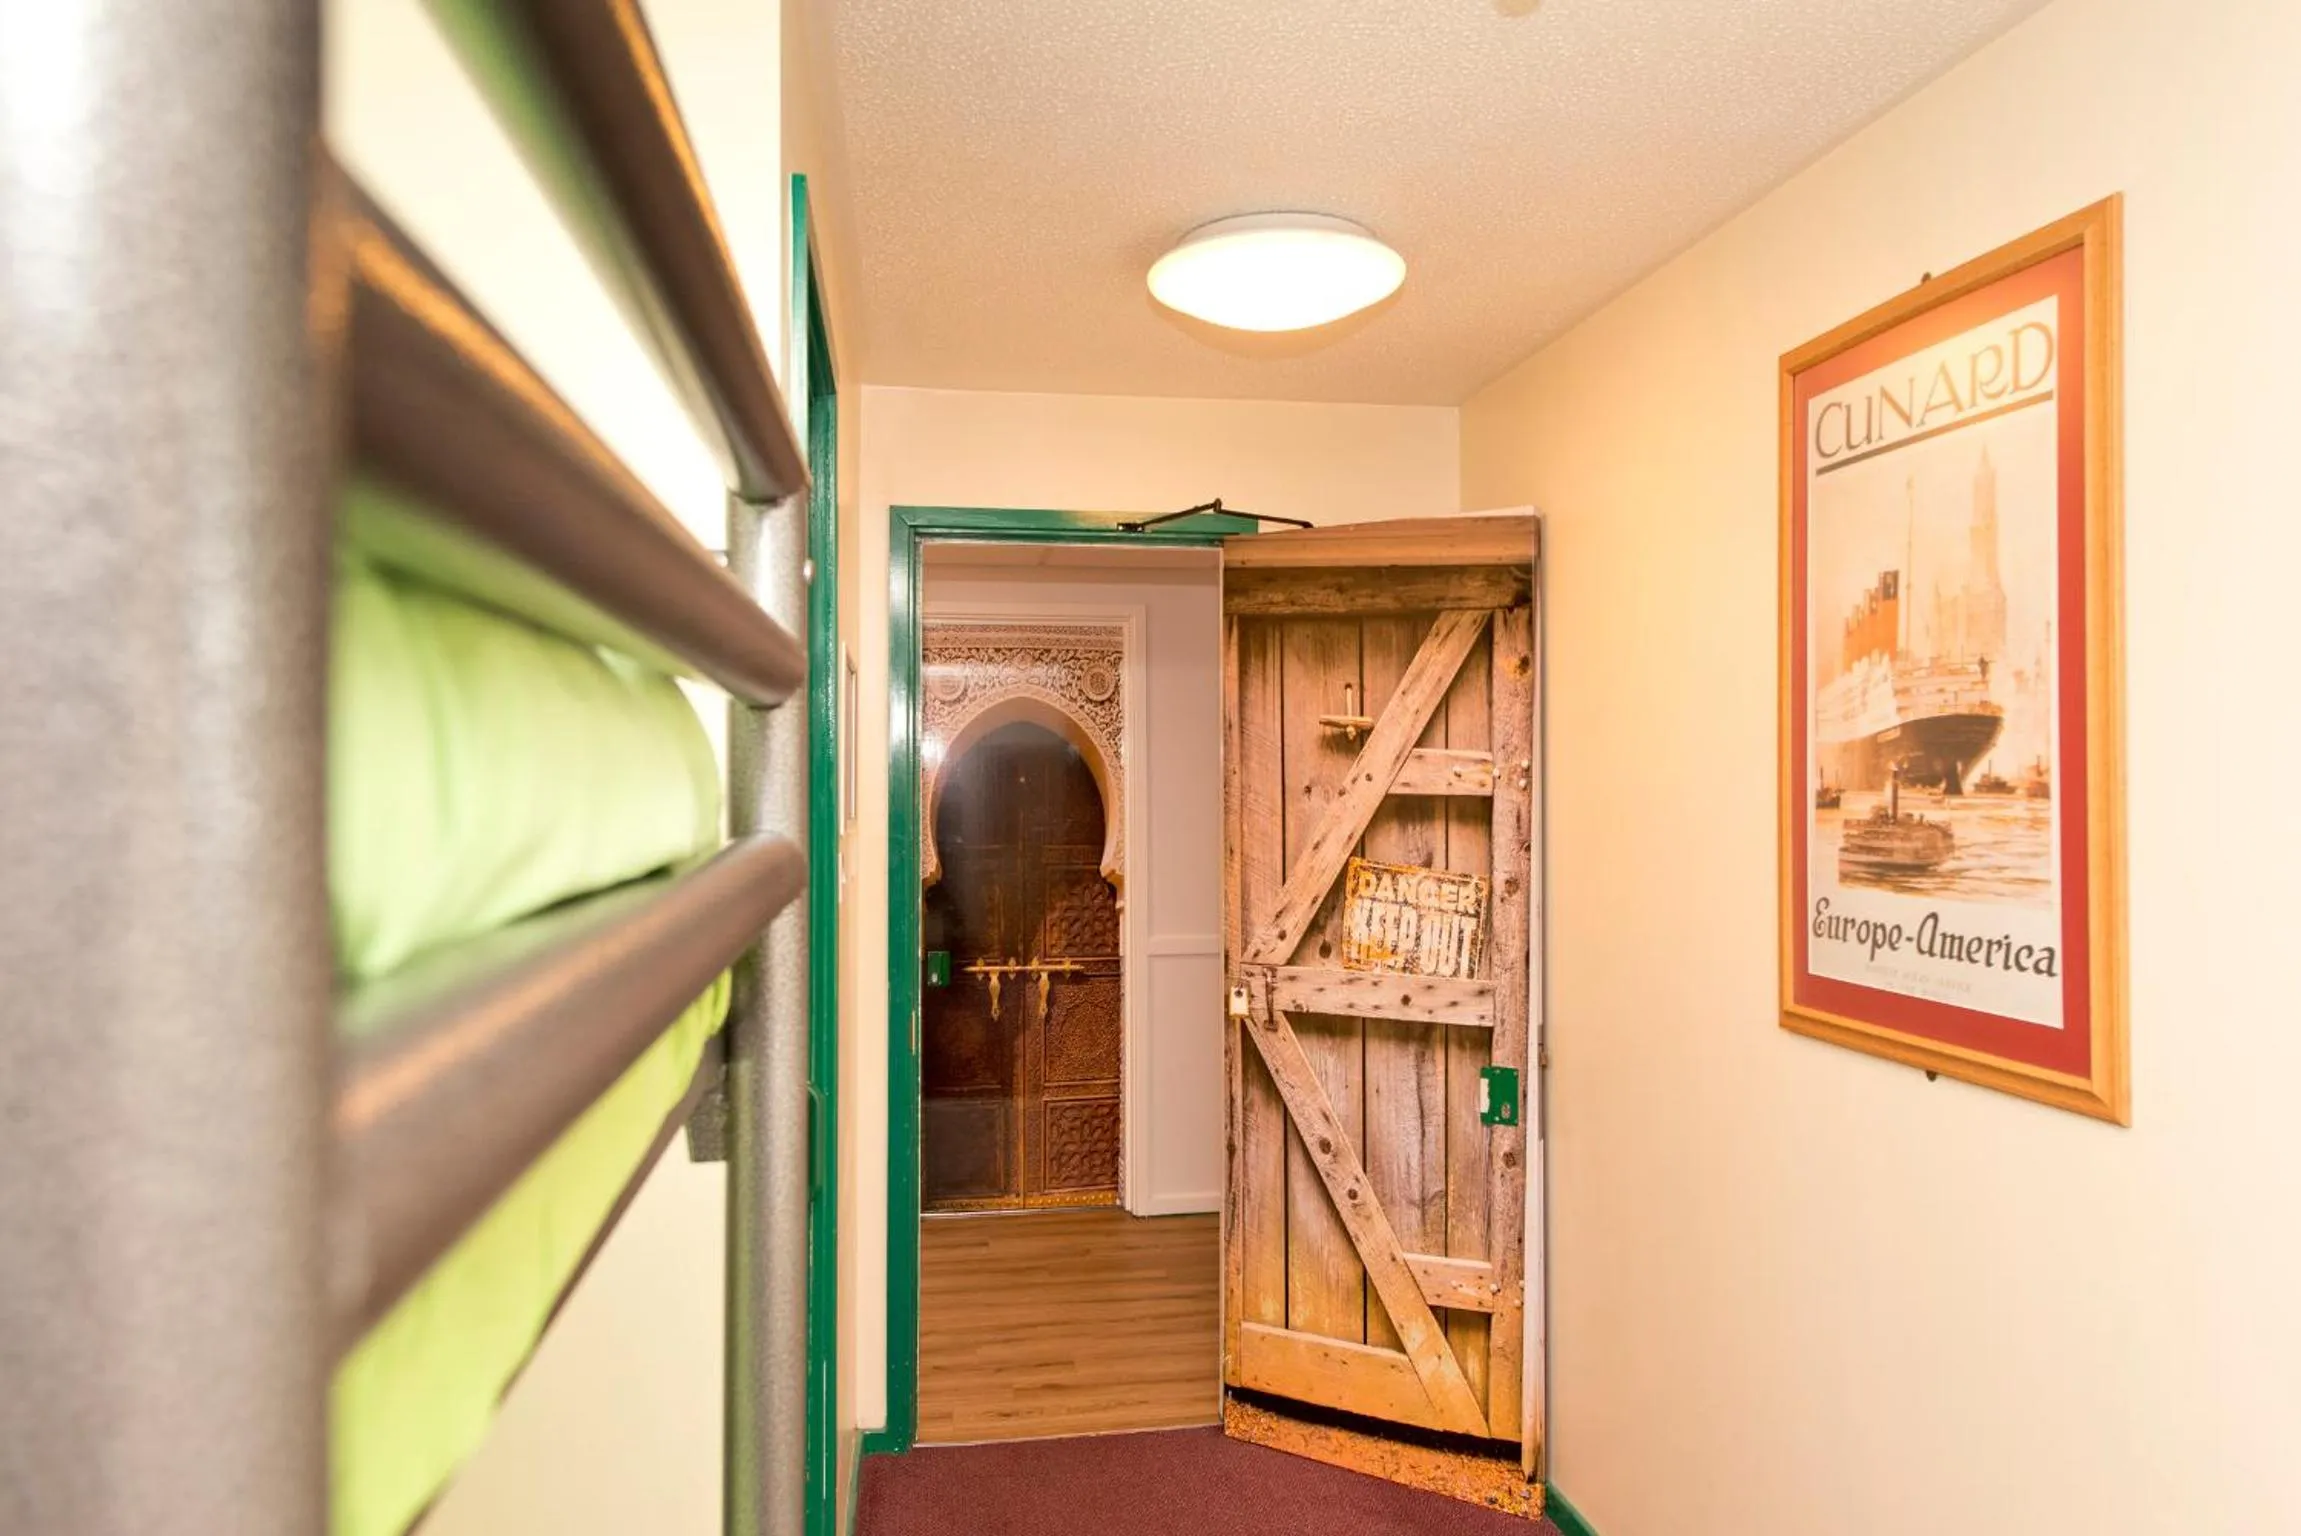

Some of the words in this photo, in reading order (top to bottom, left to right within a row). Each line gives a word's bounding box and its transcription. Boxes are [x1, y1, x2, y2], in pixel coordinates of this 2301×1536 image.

[1815, 321, 2054, 460] CUNARD
[1358, 871, 1477, 914] DANGER
[1420, 914, 1477, 978] OUT
[1813, 897, 2058, 978] Europe-America
